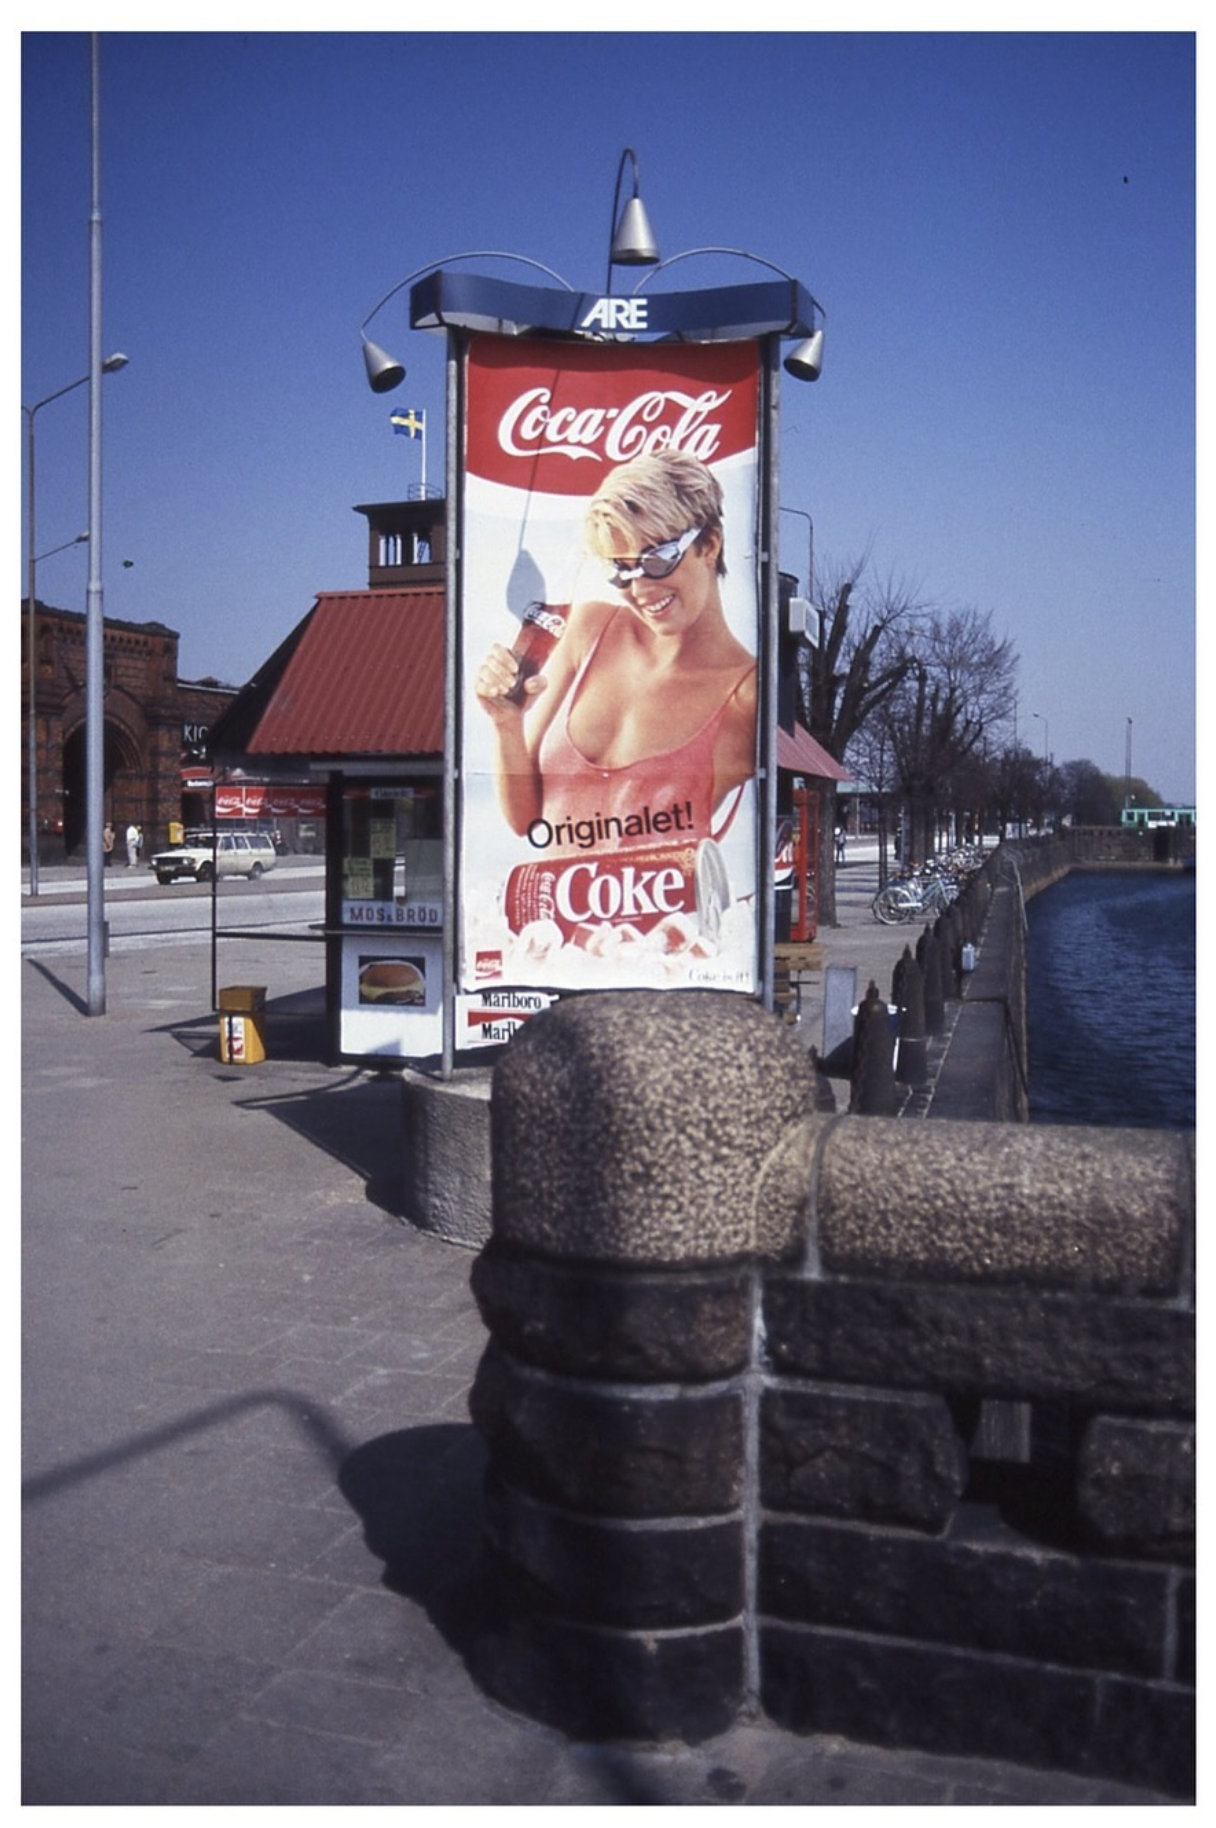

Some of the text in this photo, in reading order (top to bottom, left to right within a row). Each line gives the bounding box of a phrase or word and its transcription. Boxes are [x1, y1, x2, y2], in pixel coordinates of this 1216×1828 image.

[581, 298, 648, 329] ARE
[498, 387, 732, 462] Coca-Cola
[527, 801, 695, 849] Originalet!
[556, 862, 685, 923] Coke
[481, 992, 542, 1009] Marlboro
